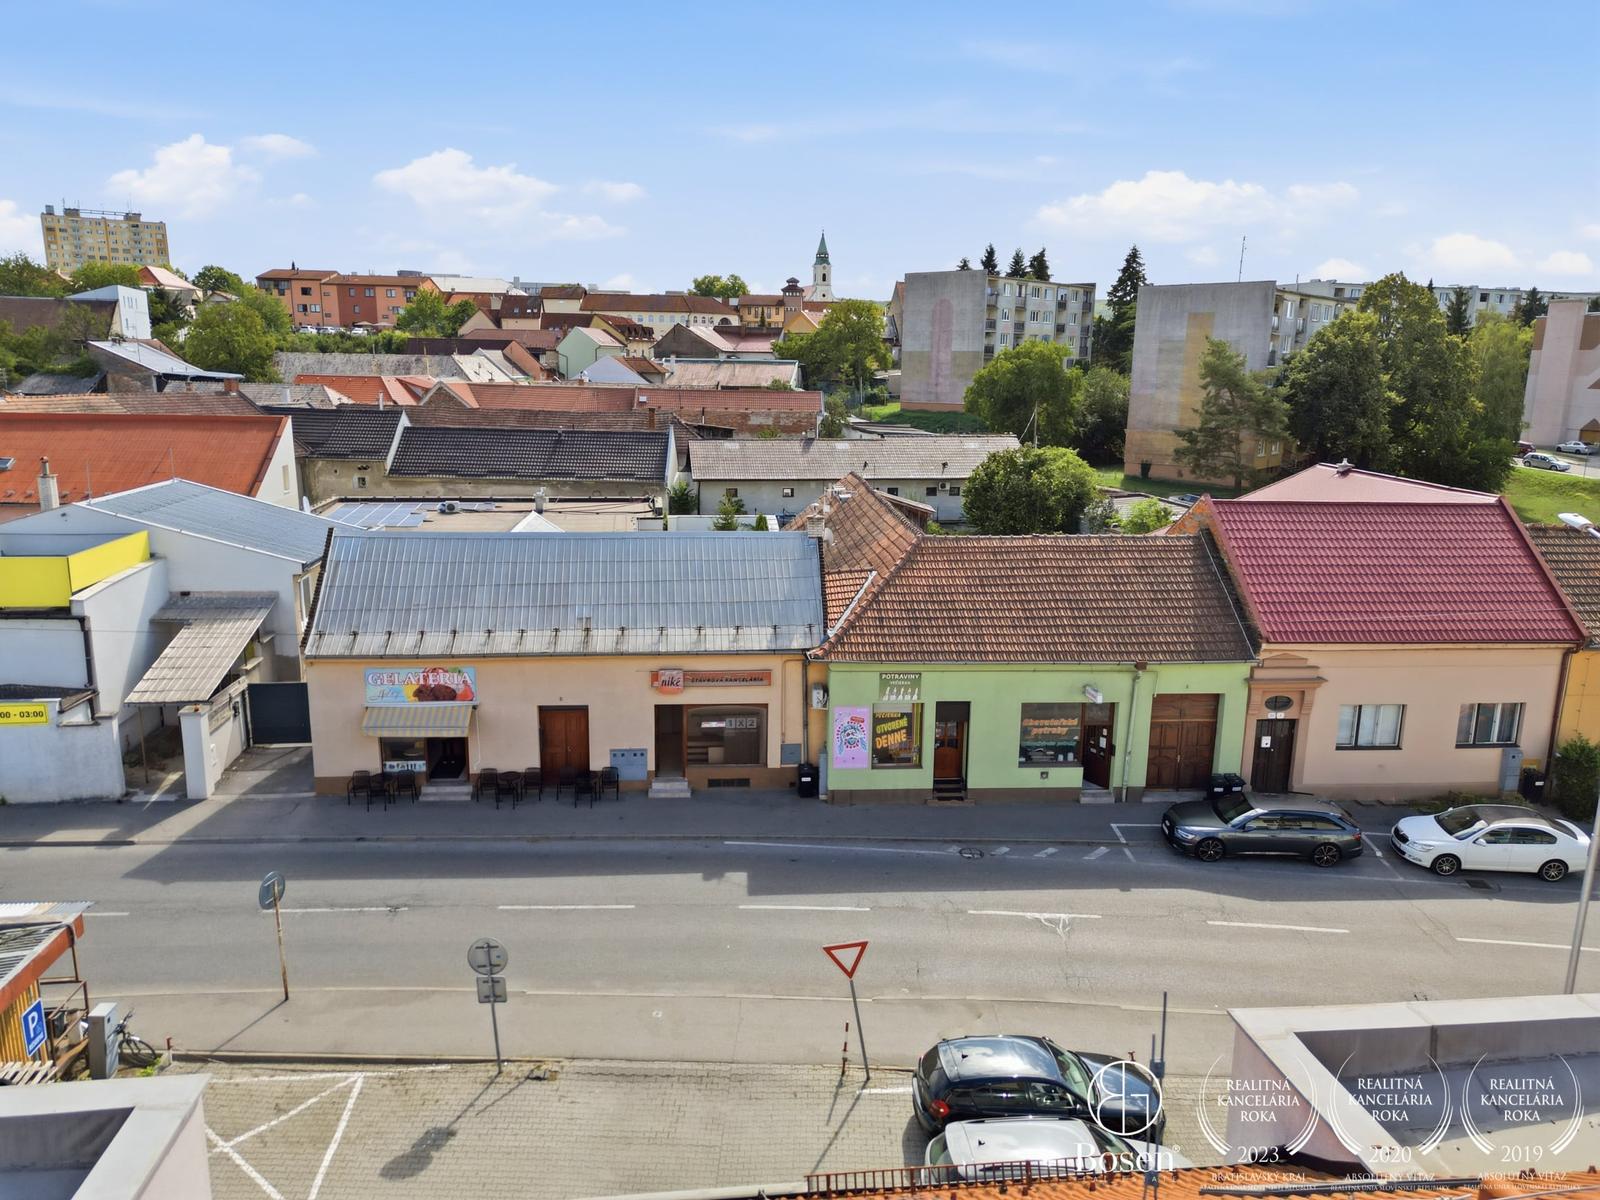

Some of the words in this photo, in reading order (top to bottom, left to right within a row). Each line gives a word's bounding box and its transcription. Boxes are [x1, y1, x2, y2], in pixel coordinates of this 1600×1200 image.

[367, 671, 472, 685] GELATERIA
[19, 710, 44, 719] 03:00
[876, 715, 908, 734] OTVORENÉ
[875, 729, 907, 750] DENNE
[28, 1011, 39, 1039] P
